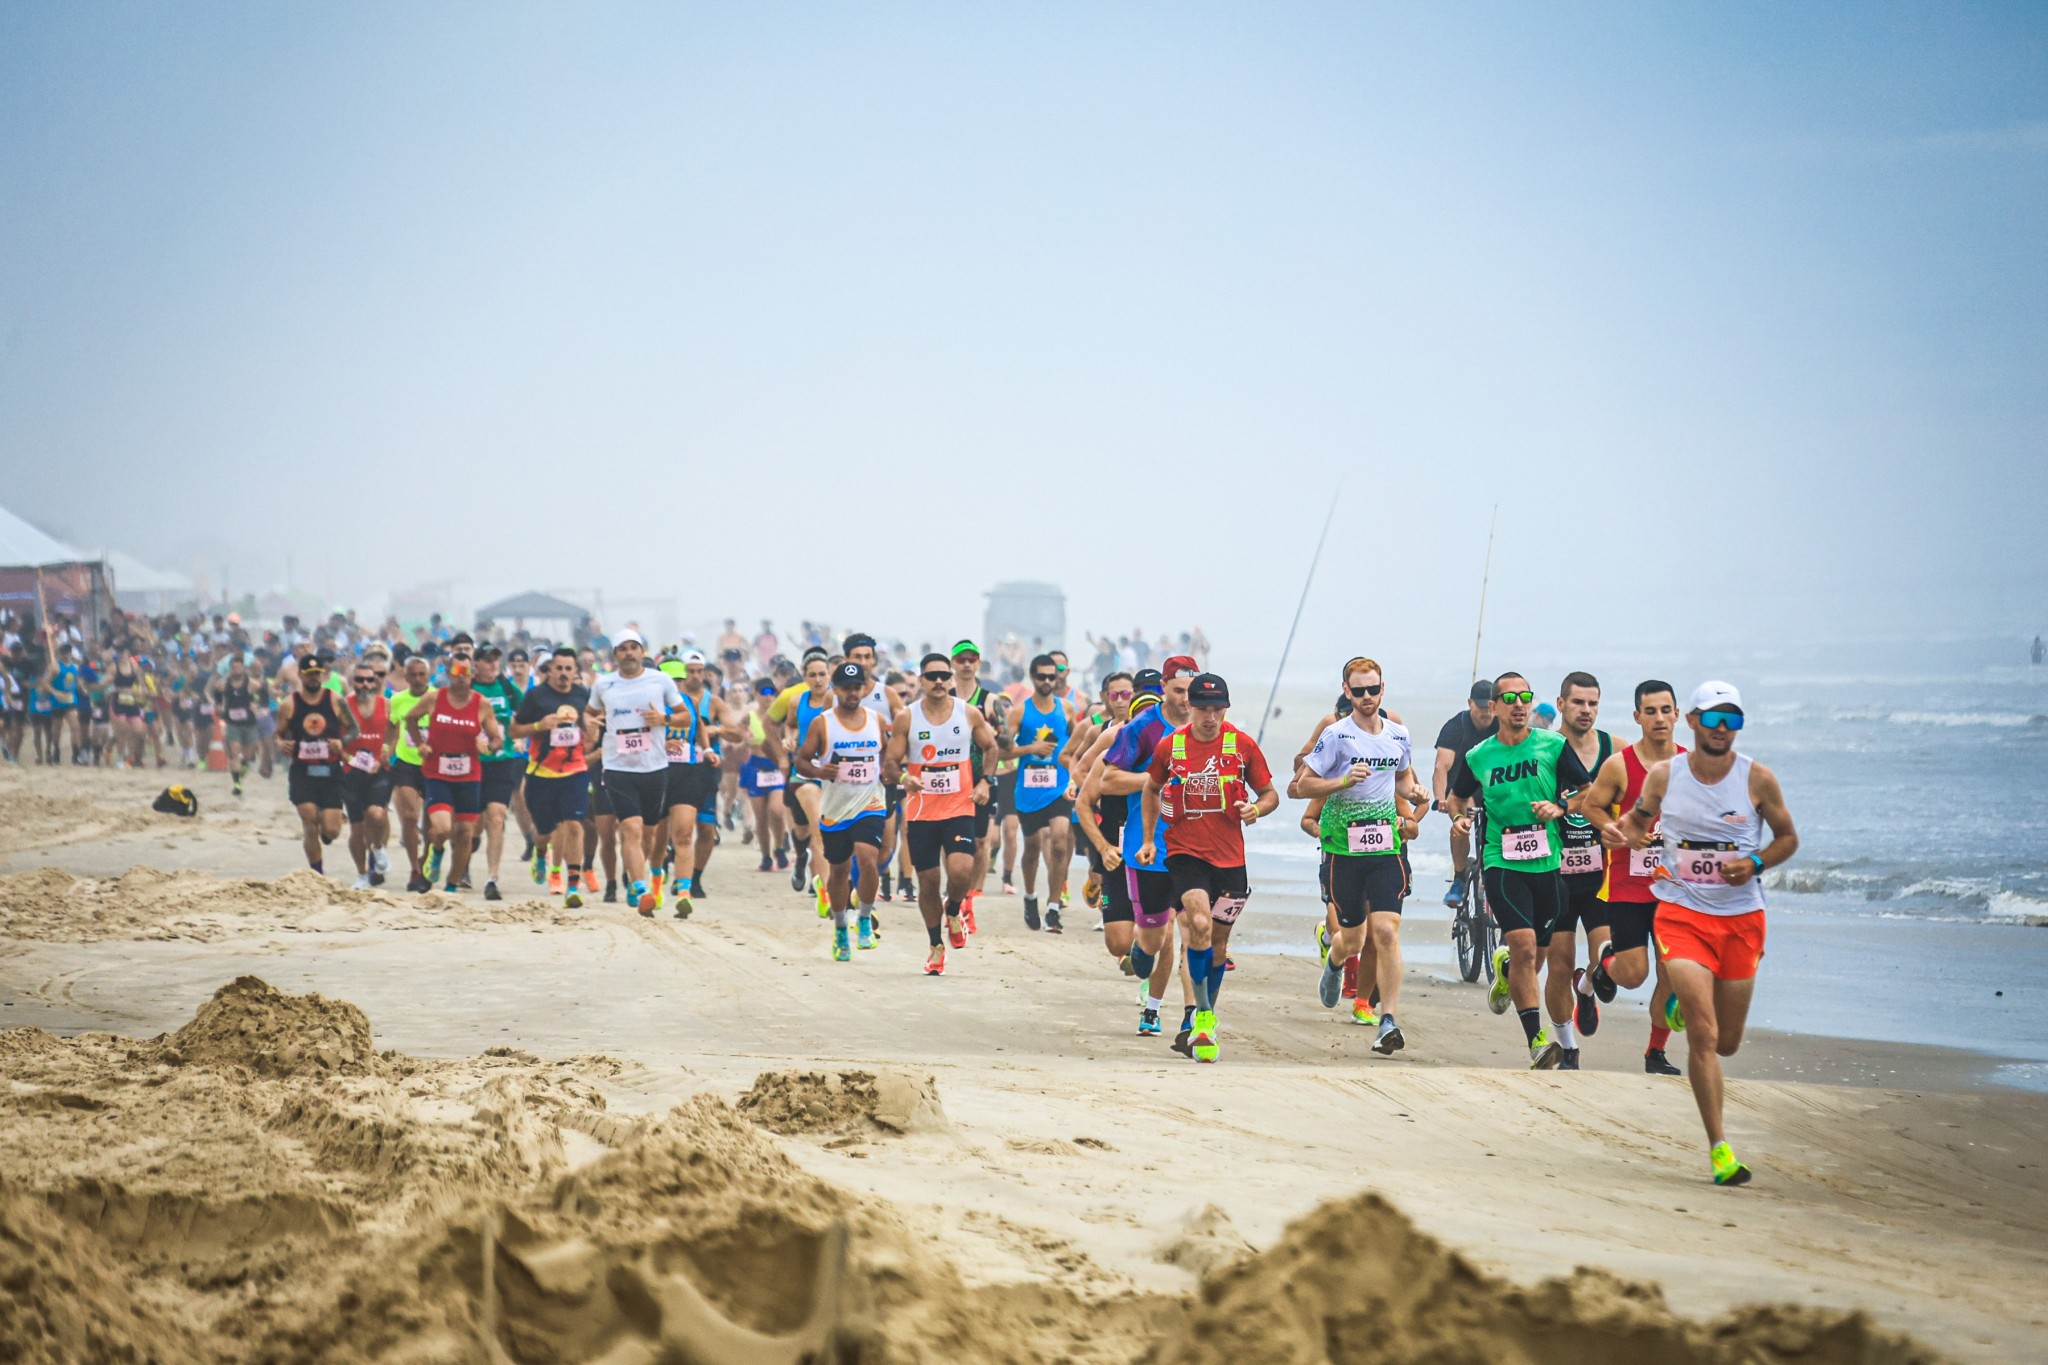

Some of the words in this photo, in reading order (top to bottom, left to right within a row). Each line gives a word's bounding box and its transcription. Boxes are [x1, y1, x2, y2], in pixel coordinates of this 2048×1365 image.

[625, 739, 643, 749] 501
[847, 768, 867, 778] 481
[1031, 774, 1049, 783] 636
[930, 778, 950, 788] 661
[1359, 832, 1383, 845] 480
[1514, 839, 1538, 853] 469
[1566, 854, 1592, 867] 638
[1643, 855, 1660, 869] 60
[1691, 860, 1723, 876] 601
